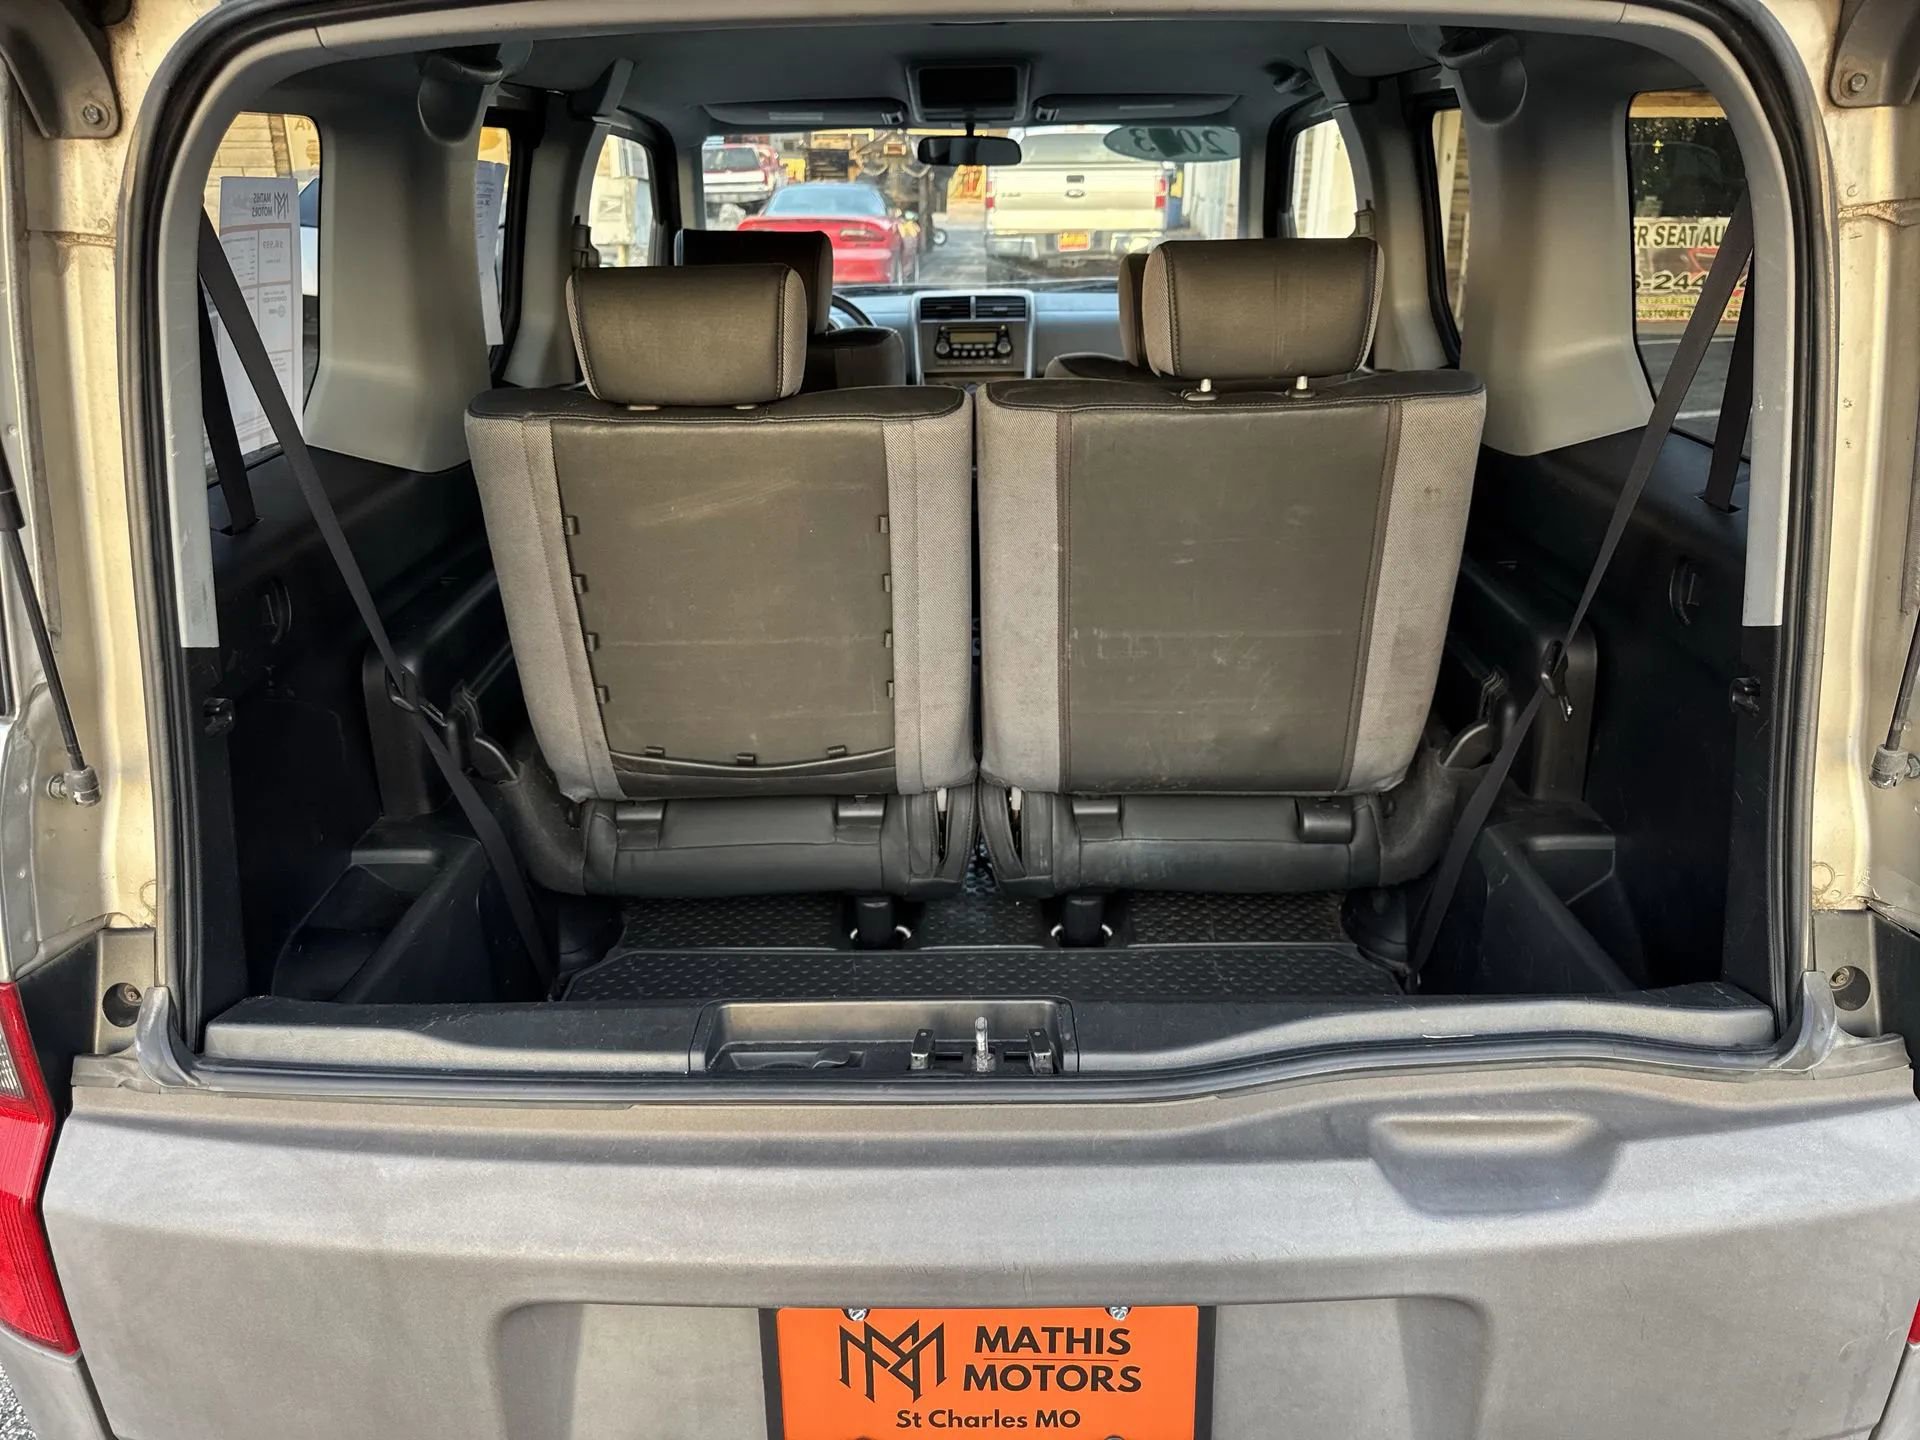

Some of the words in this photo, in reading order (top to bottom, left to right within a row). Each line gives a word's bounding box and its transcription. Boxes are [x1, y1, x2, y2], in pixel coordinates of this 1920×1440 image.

[1654, 225, 1698, 247] SEAT
[973, 1325, 1132, 1356] MATHIS
[962, 1363, 1143, 1393] MOTORS
[895, 1409, 923, 1429] St
[928, 1408, 1028, 1429] Charles
[1035, 1409, 1082, 1429] MO
